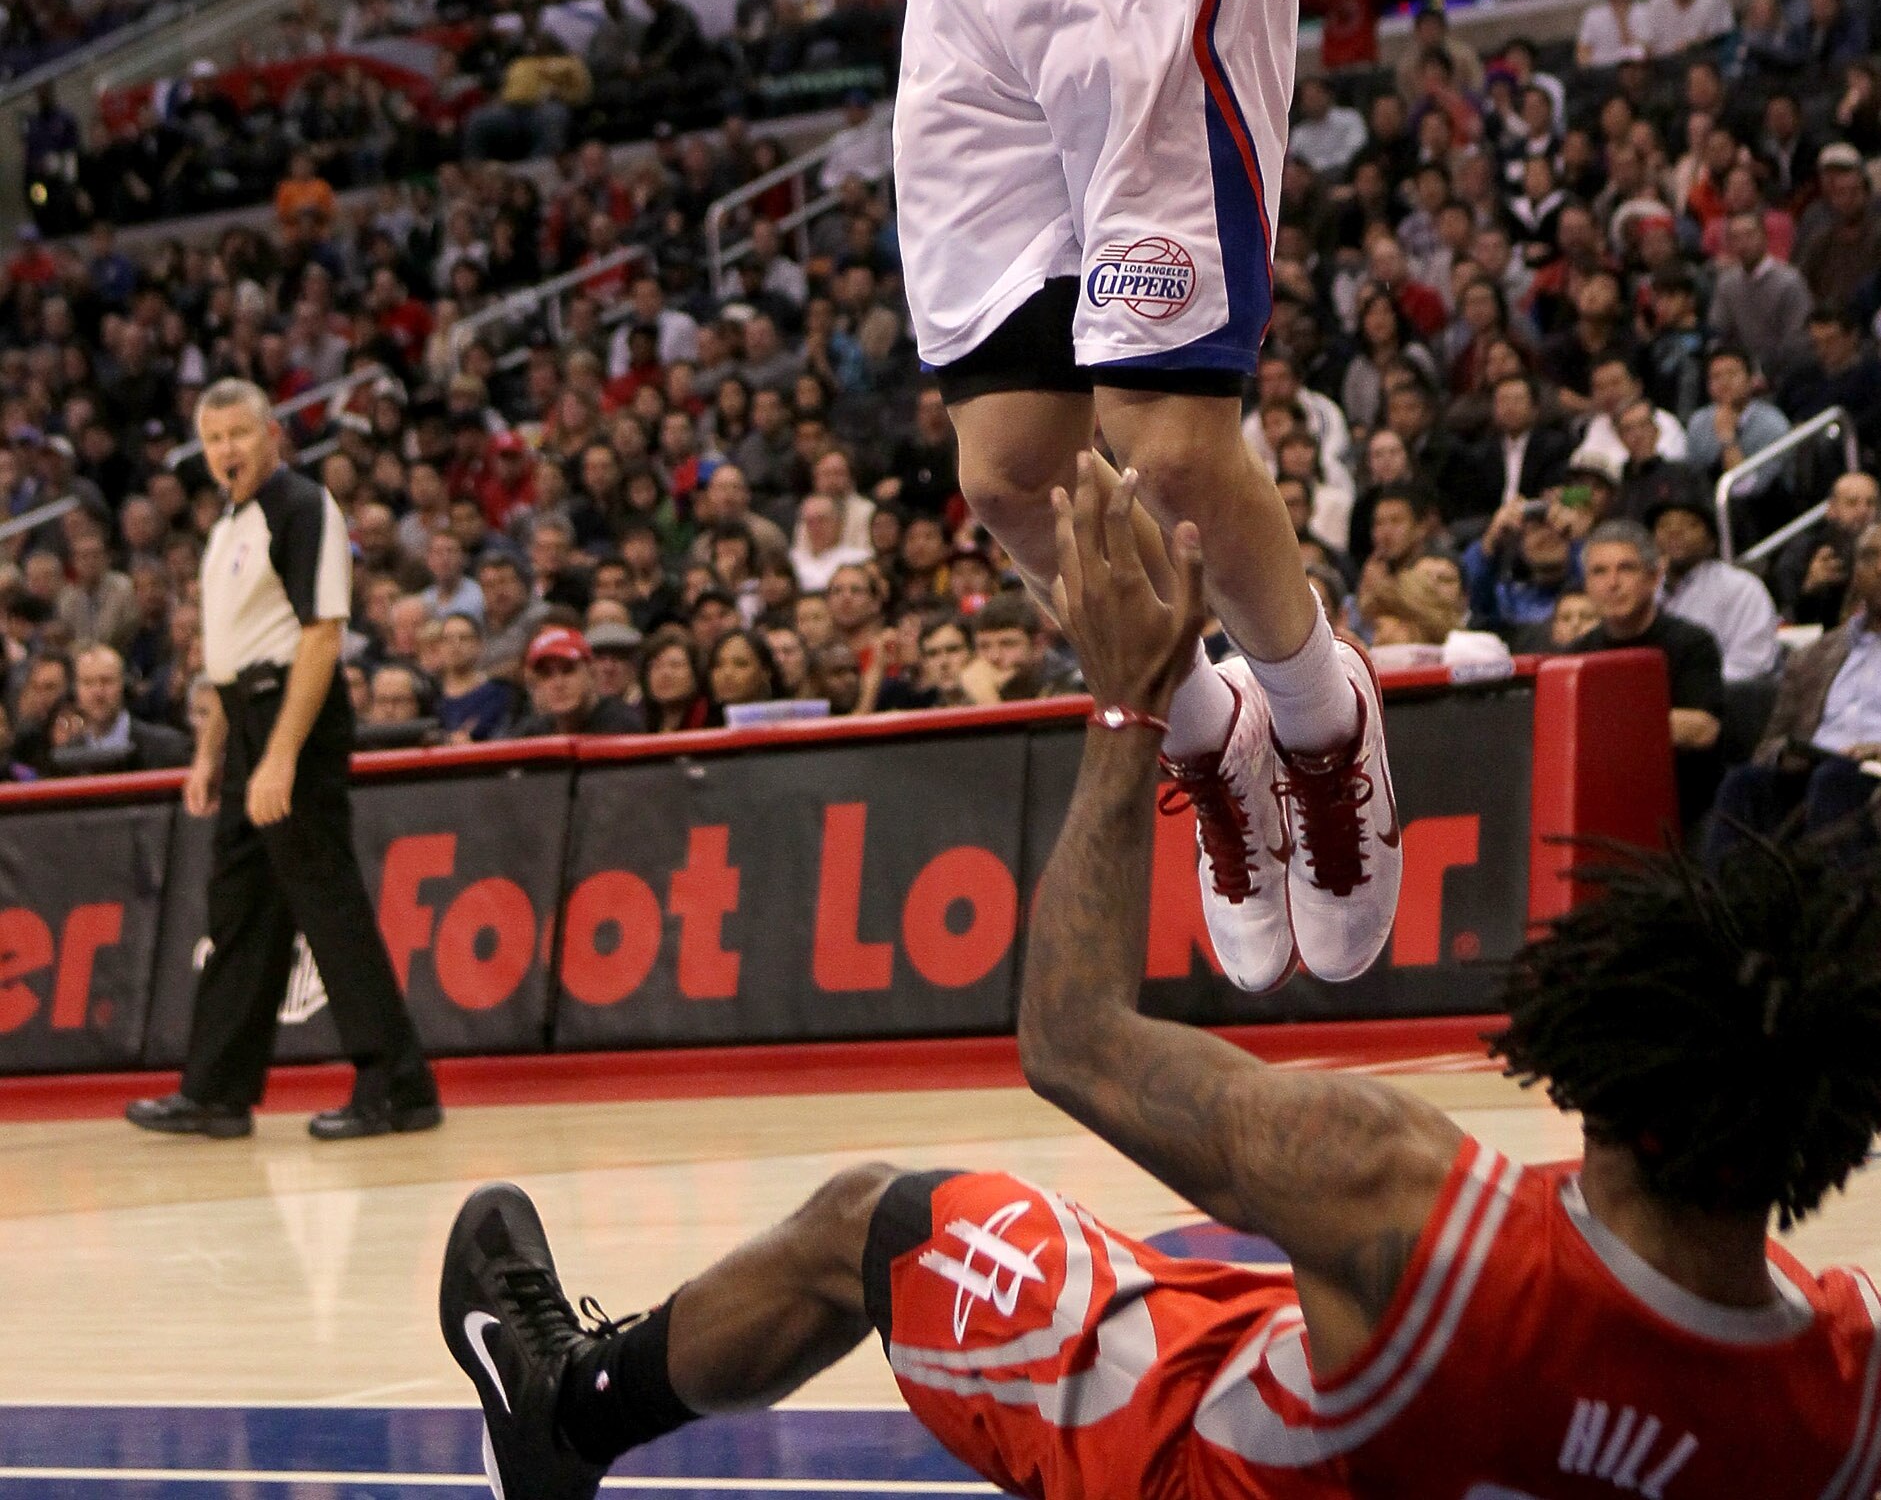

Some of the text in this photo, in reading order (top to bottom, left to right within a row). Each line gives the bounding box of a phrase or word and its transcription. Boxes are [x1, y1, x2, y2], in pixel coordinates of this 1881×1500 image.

[1087, 262, 1187, 307] CLIPPERS
[1124, 264, 1189, 277] LOS ANGELES
[1557, 1397, 1699, 1499] HILL
